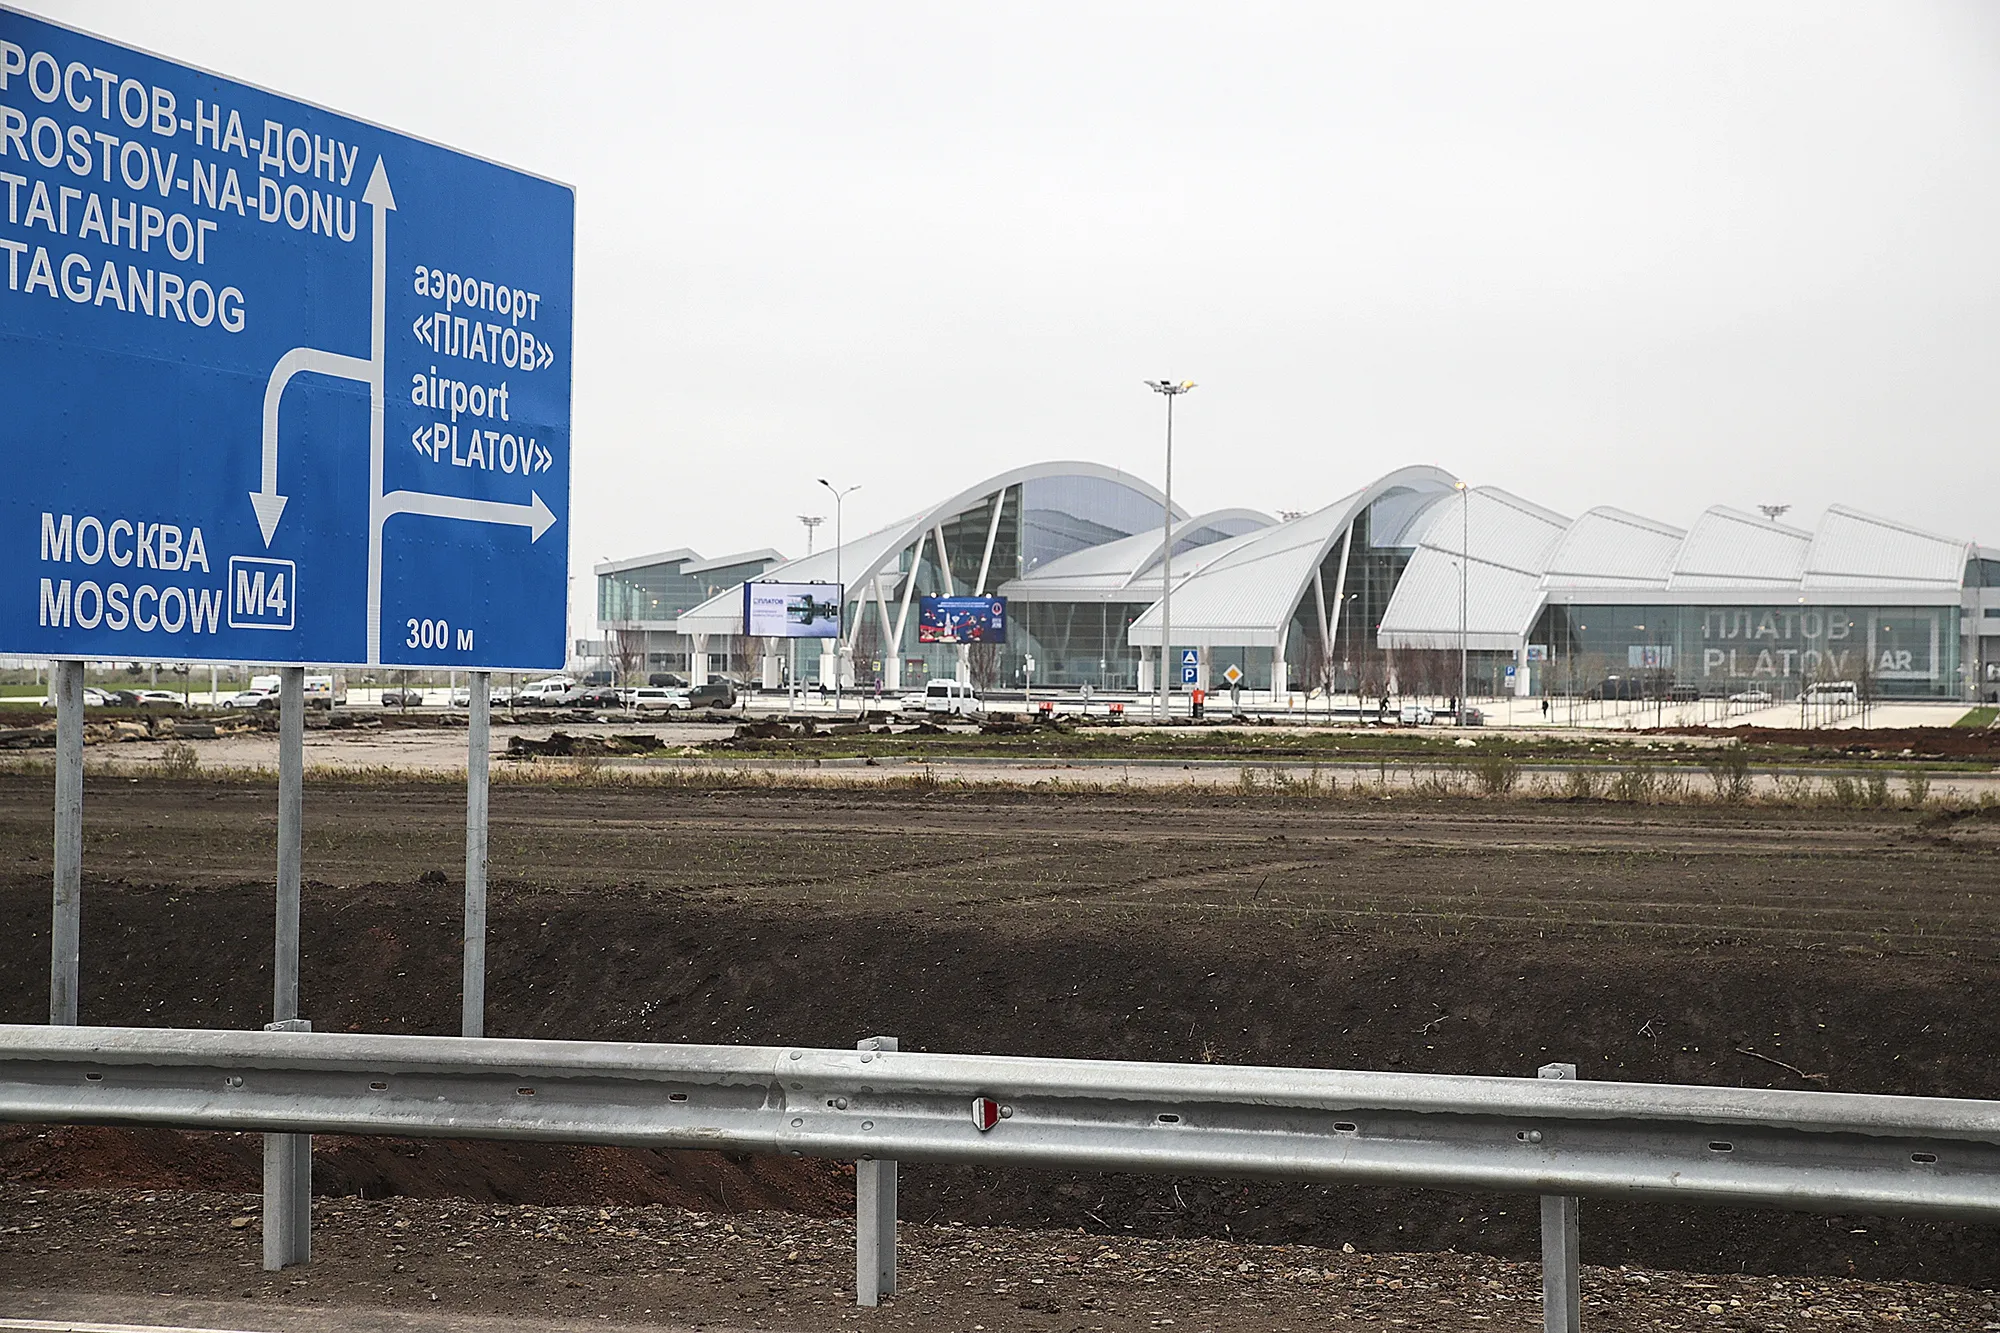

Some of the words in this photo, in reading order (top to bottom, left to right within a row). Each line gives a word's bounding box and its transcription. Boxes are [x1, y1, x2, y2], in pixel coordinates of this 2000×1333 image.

[0, 40, 358, 186] РОСТОВ-НА-ДОНУ
[0, 105, 356, 242] ROSTOV-NA-DONU
[0, 173, 217, 264] ТАГАНРОГ
[0, 239, 245, 333] TAGANROG
[414, 265, 540, 326] аэропорт
[412, 312, 554, 372] «ПЛАТОВ»
[411, 365, 509, 422] airport
[411, 422, 553, 476] «PLATOV»
[40, 511, 210, 573] МОСКВА
[39, 577, 223, 635] MOSCOW
[405, 618, 449, 650] 300
[1703, 610, 1850, 639] ПЛАТОВ
[1703, 649, 1849, 678] PLATOV
[1879, 650, 1912, 670] AR
